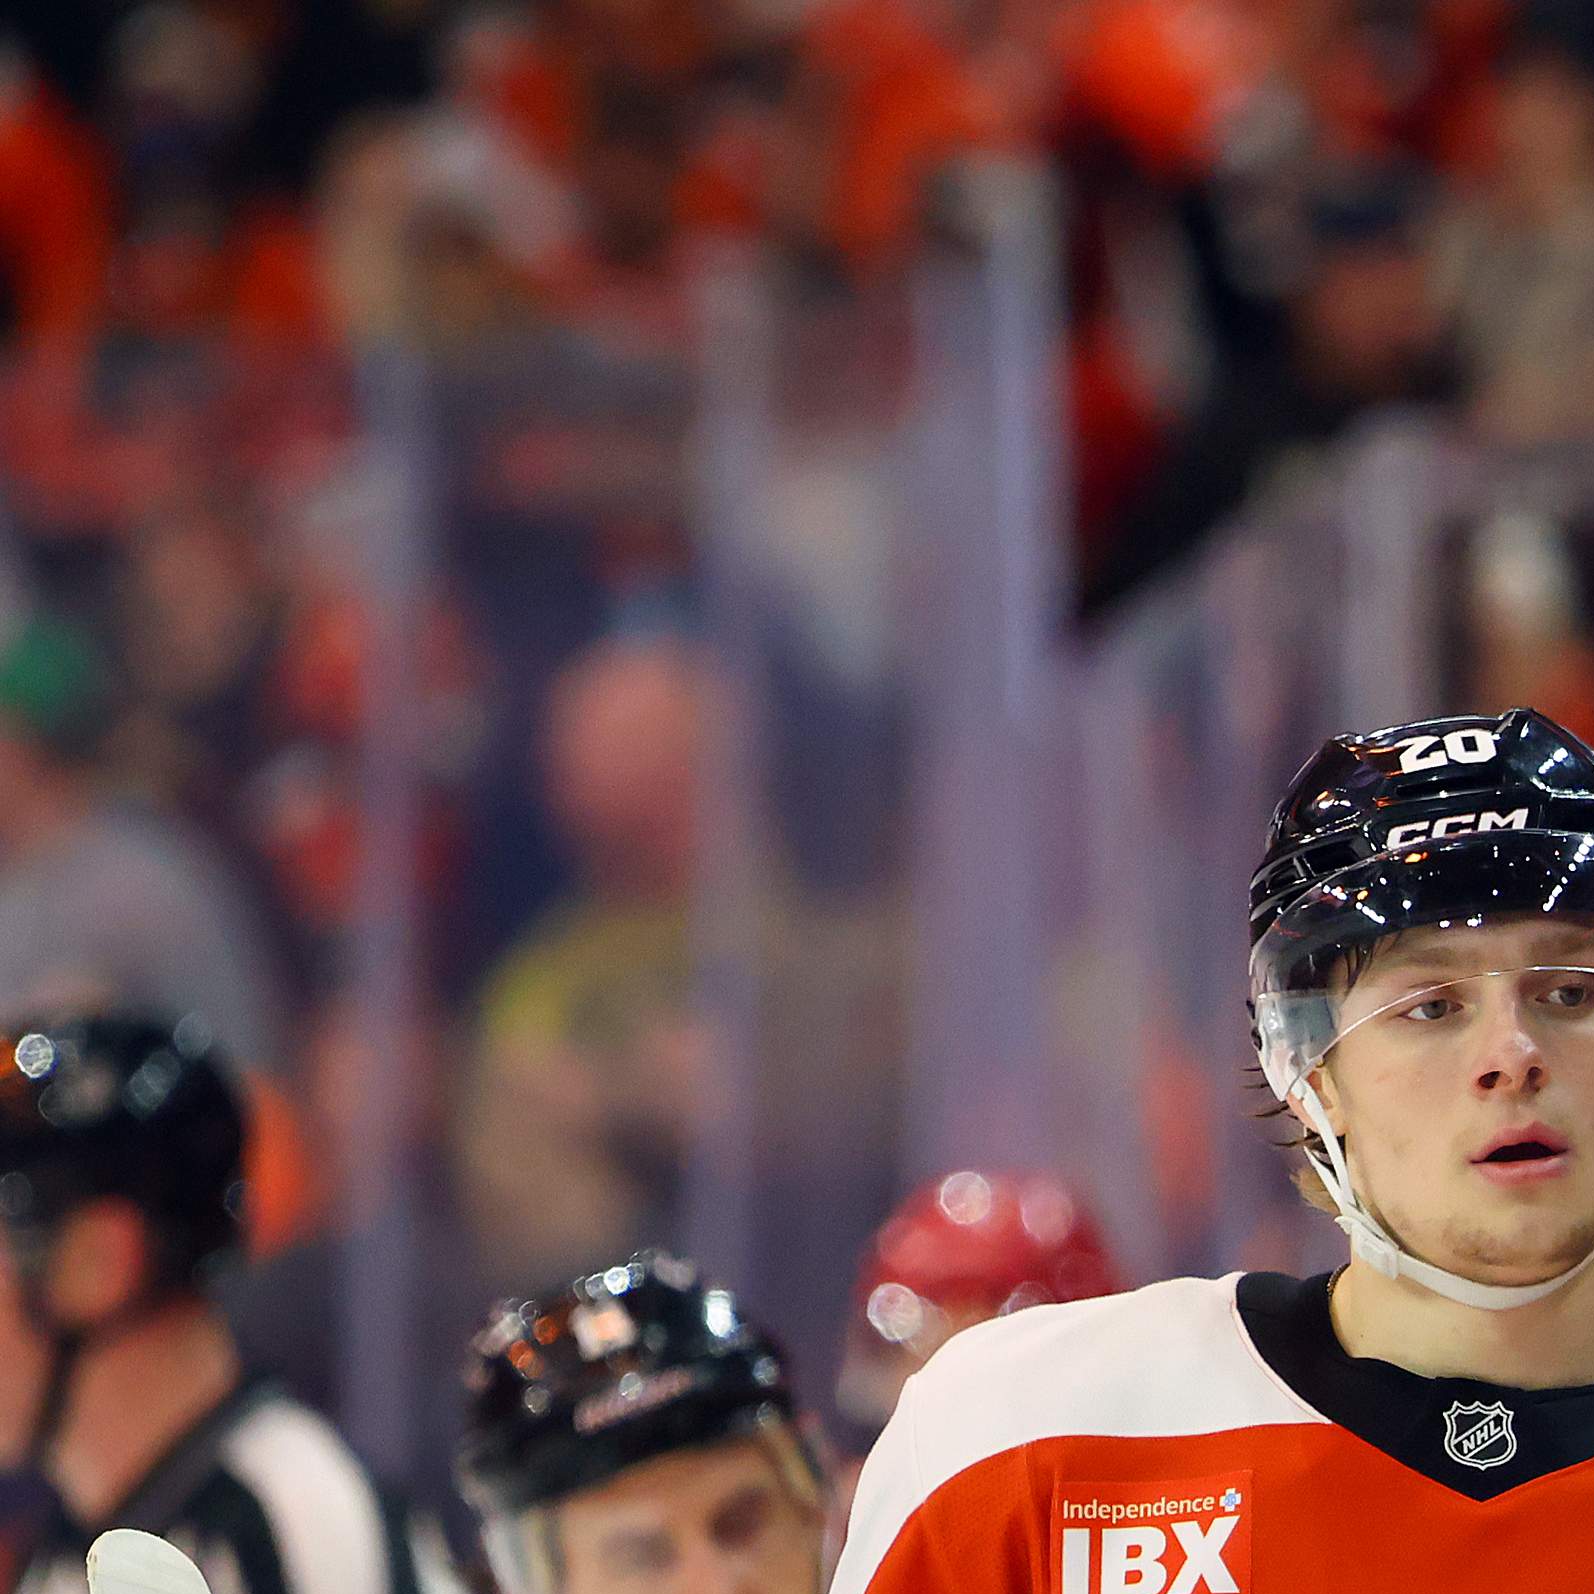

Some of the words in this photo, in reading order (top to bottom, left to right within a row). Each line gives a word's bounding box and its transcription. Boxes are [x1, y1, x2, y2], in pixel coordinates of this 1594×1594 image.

[1397, 728, 1499, 774] 20
[1387, 808, 1529, 850] CCM
[1462, 1417, 1502, 1455] NHL
[1063, 1494, 1216, 1525] Independence
